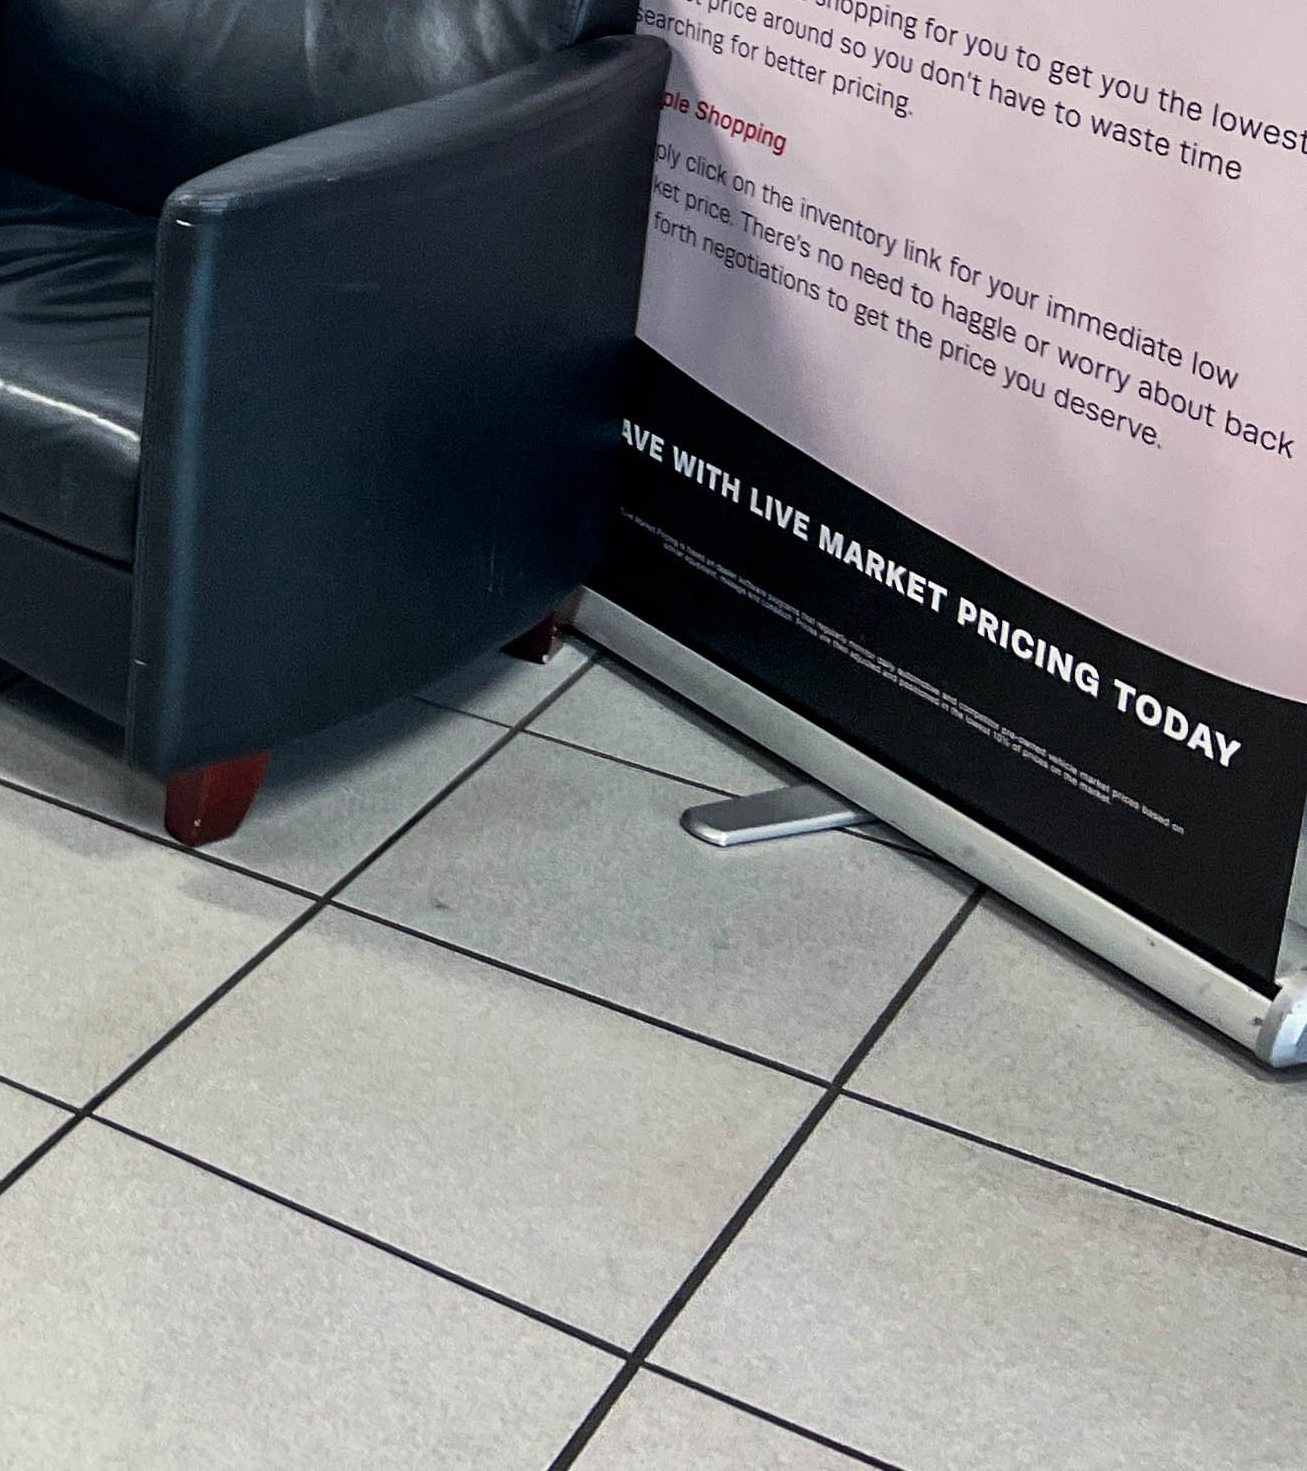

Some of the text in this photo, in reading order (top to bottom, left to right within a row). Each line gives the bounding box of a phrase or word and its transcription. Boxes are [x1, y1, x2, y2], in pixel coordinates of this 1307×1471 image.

[636, 6, 913, 119] searching for better pricing.
[695, 100, 786, 156] Shopping
[764, 10, 834, 48] around
[840, 36, 866, 58] so
[872, 47, 914, 73] you
[920, 60, 982, 97] don't
[989, 79, 1046, 116] have
[1054, 101, 1081, 127] to
[1091, 115, 1170, 156] waste
[1180, 141, 1242, 180] time
[925, 18, 959, 46] for
[964, 33, 1008, 61] you
[1016, 46, 1040, 72] to
[1049, 60, 1093, 85] get
[1099, 74, 1148, 104] you
[1158, 88, 1202, 121] the
[654, 211, 1162, 449] forth negotiations to get the price you deserve.
[672, 445, 740, 503] WITH
[750, 487, 810, 541] LIVE
[818, 524, 948, 613] MARKET
[957, 597, 1100, 698] PRICING
[1114, 678, 1242, 768] TODAY
